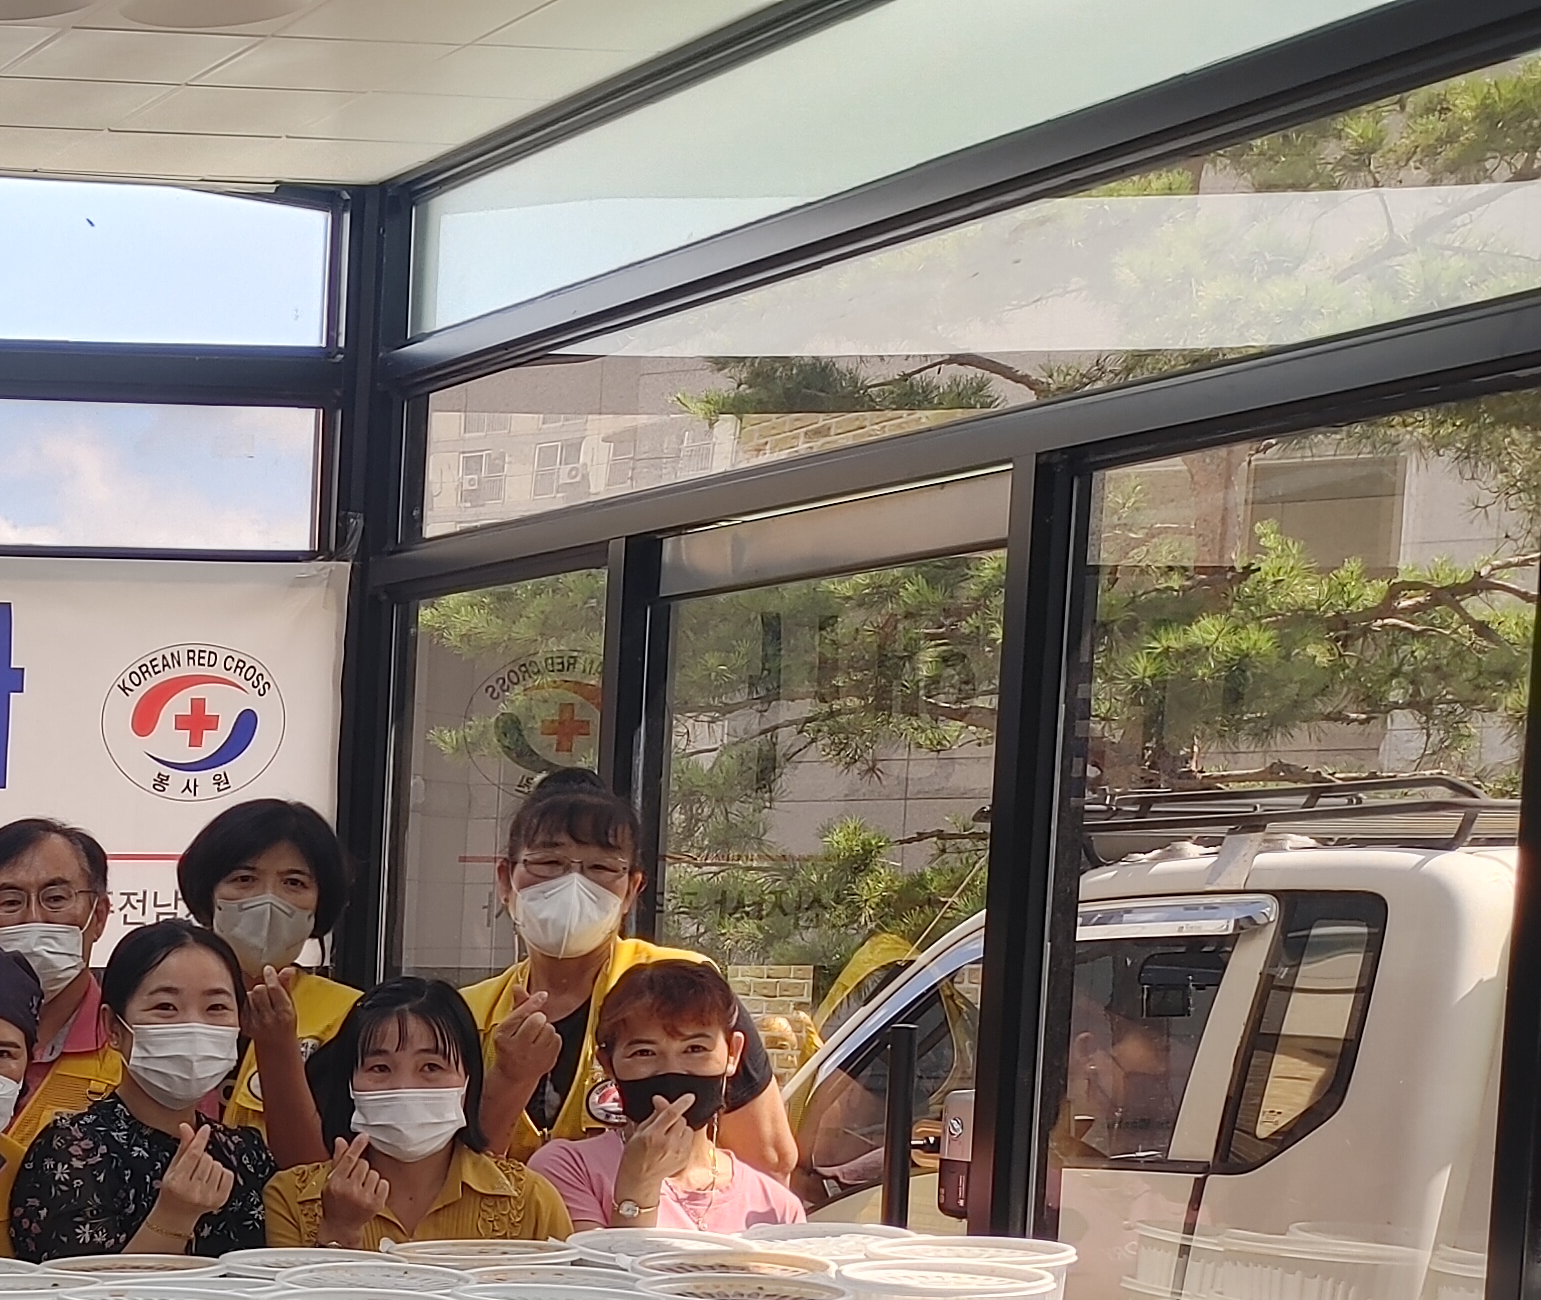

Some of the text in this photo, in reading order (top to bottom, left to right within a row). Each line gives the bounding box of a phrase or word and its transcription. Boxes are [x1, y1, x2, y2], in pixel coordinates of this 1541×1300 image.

[117, 649, 271, 697] KOREAN RED CROSS
